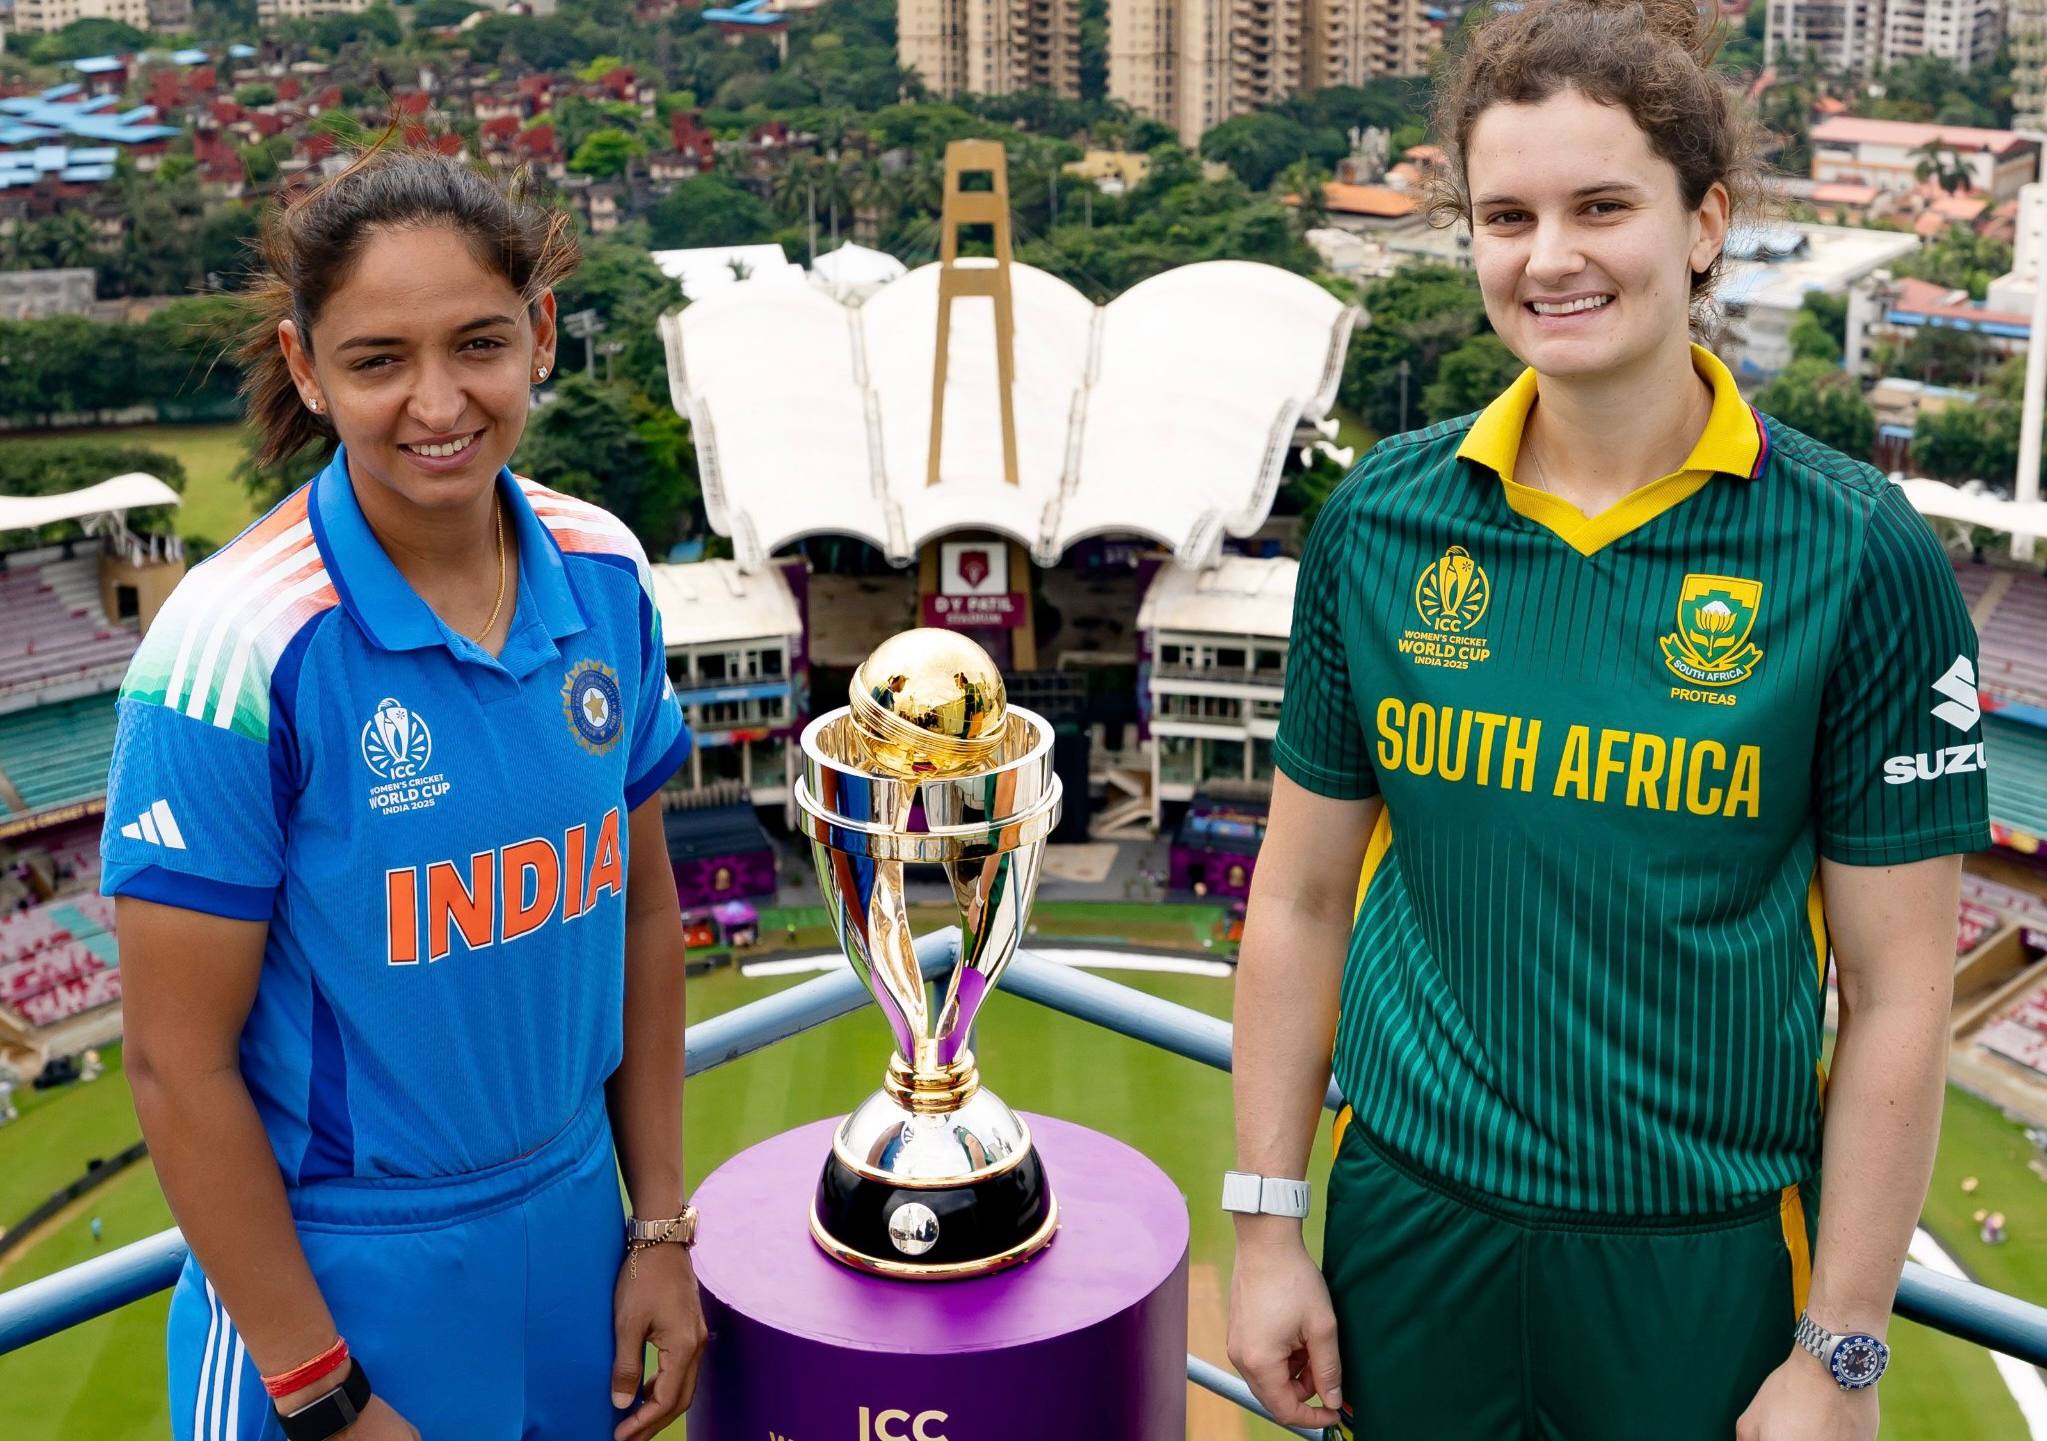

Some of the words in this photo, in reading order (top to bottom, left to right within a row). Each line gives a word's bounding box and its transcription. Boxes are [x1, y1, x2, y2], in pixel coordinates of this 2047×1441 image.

[1434, 617, 1462, 632] ICC
[1404, 629, 1448, 643] WOMEN'S
[1449, 635, 1487, 647] CRICKET
[1398, 639, 1456, 658] WORLD
[1458, 646, 1490, 662] CUP
[1414, 656, 1441, 667] INDIA
[1442, 659, 1469, 670] 2025
[1673, 659, 1705, 680] SOUTH
[1706, 667, 1744, 682] AFRICA
[1670, 687, 1737, 706] PROTEAS
[1376, 697, 1542, 793] SOUTH
[1552, 724, 1762, 819] AFRICA
[390, 763, 416, 780] ICC
[408, 773, 444, 787] CRICKET
[368, 788, 419, 810] WORLD
[421, 782, 451, 798] CUP
[382, 803, 410, 816] INDIA
[410, 798, 436, 811] 2025
[385, 806, 622, 966] INDIA
[858, 1405, 950, 1441] ICC
